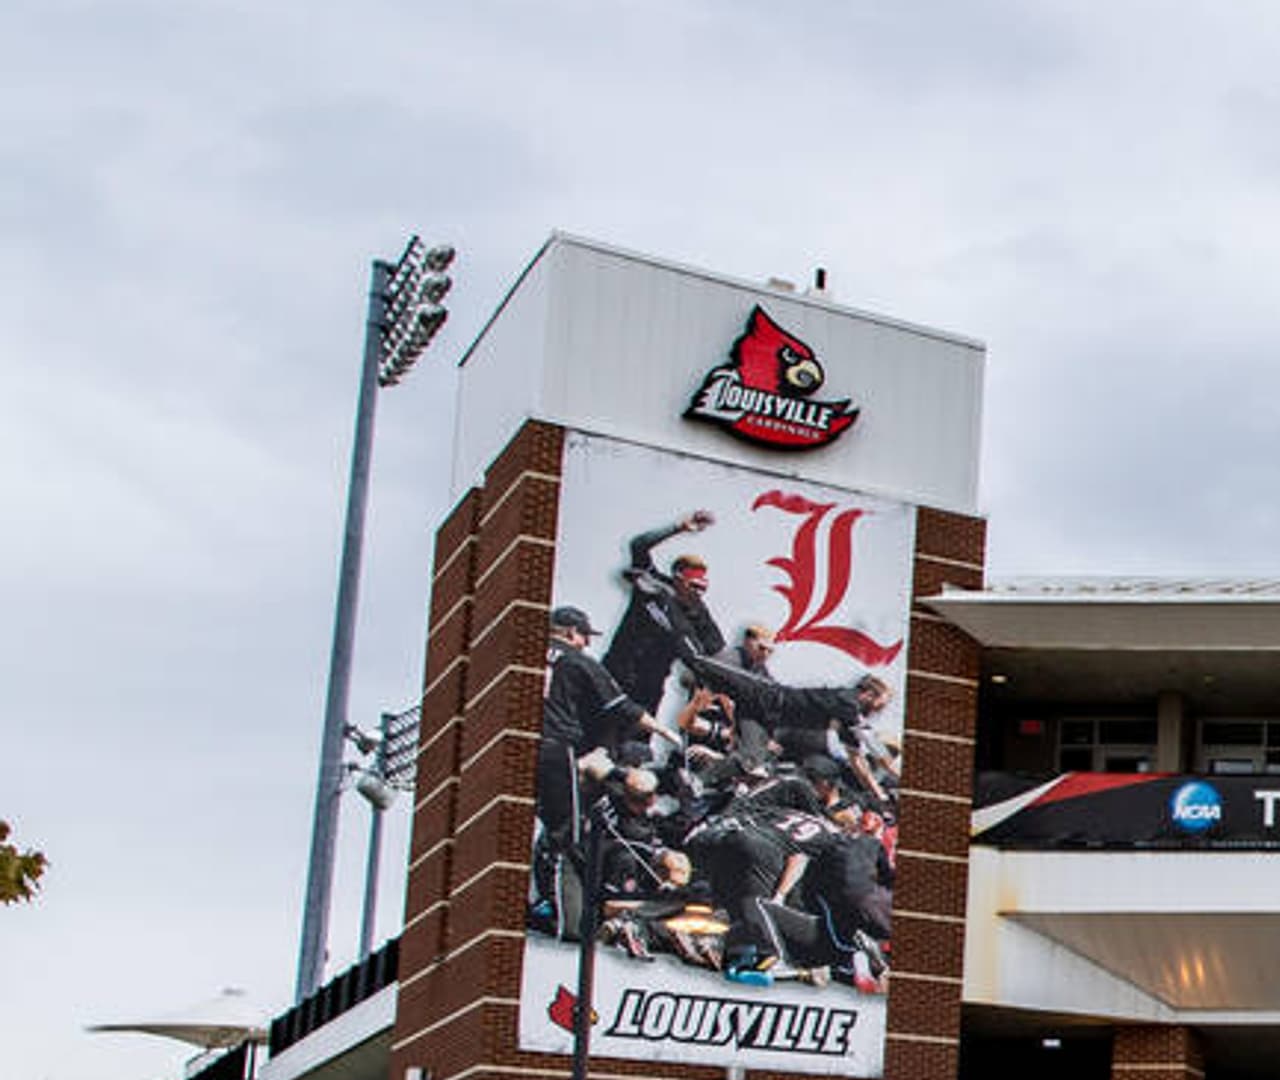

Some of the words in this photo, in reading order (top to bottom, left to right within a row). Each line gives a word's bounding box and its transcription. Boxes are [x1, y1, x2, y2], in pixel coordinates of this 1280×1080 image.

[694, 368, 834, 430] LOUISVILLE
[1172, 803, 1222, 820] NCAA
[604, 989, 858, 1057] LOUISVILLE
